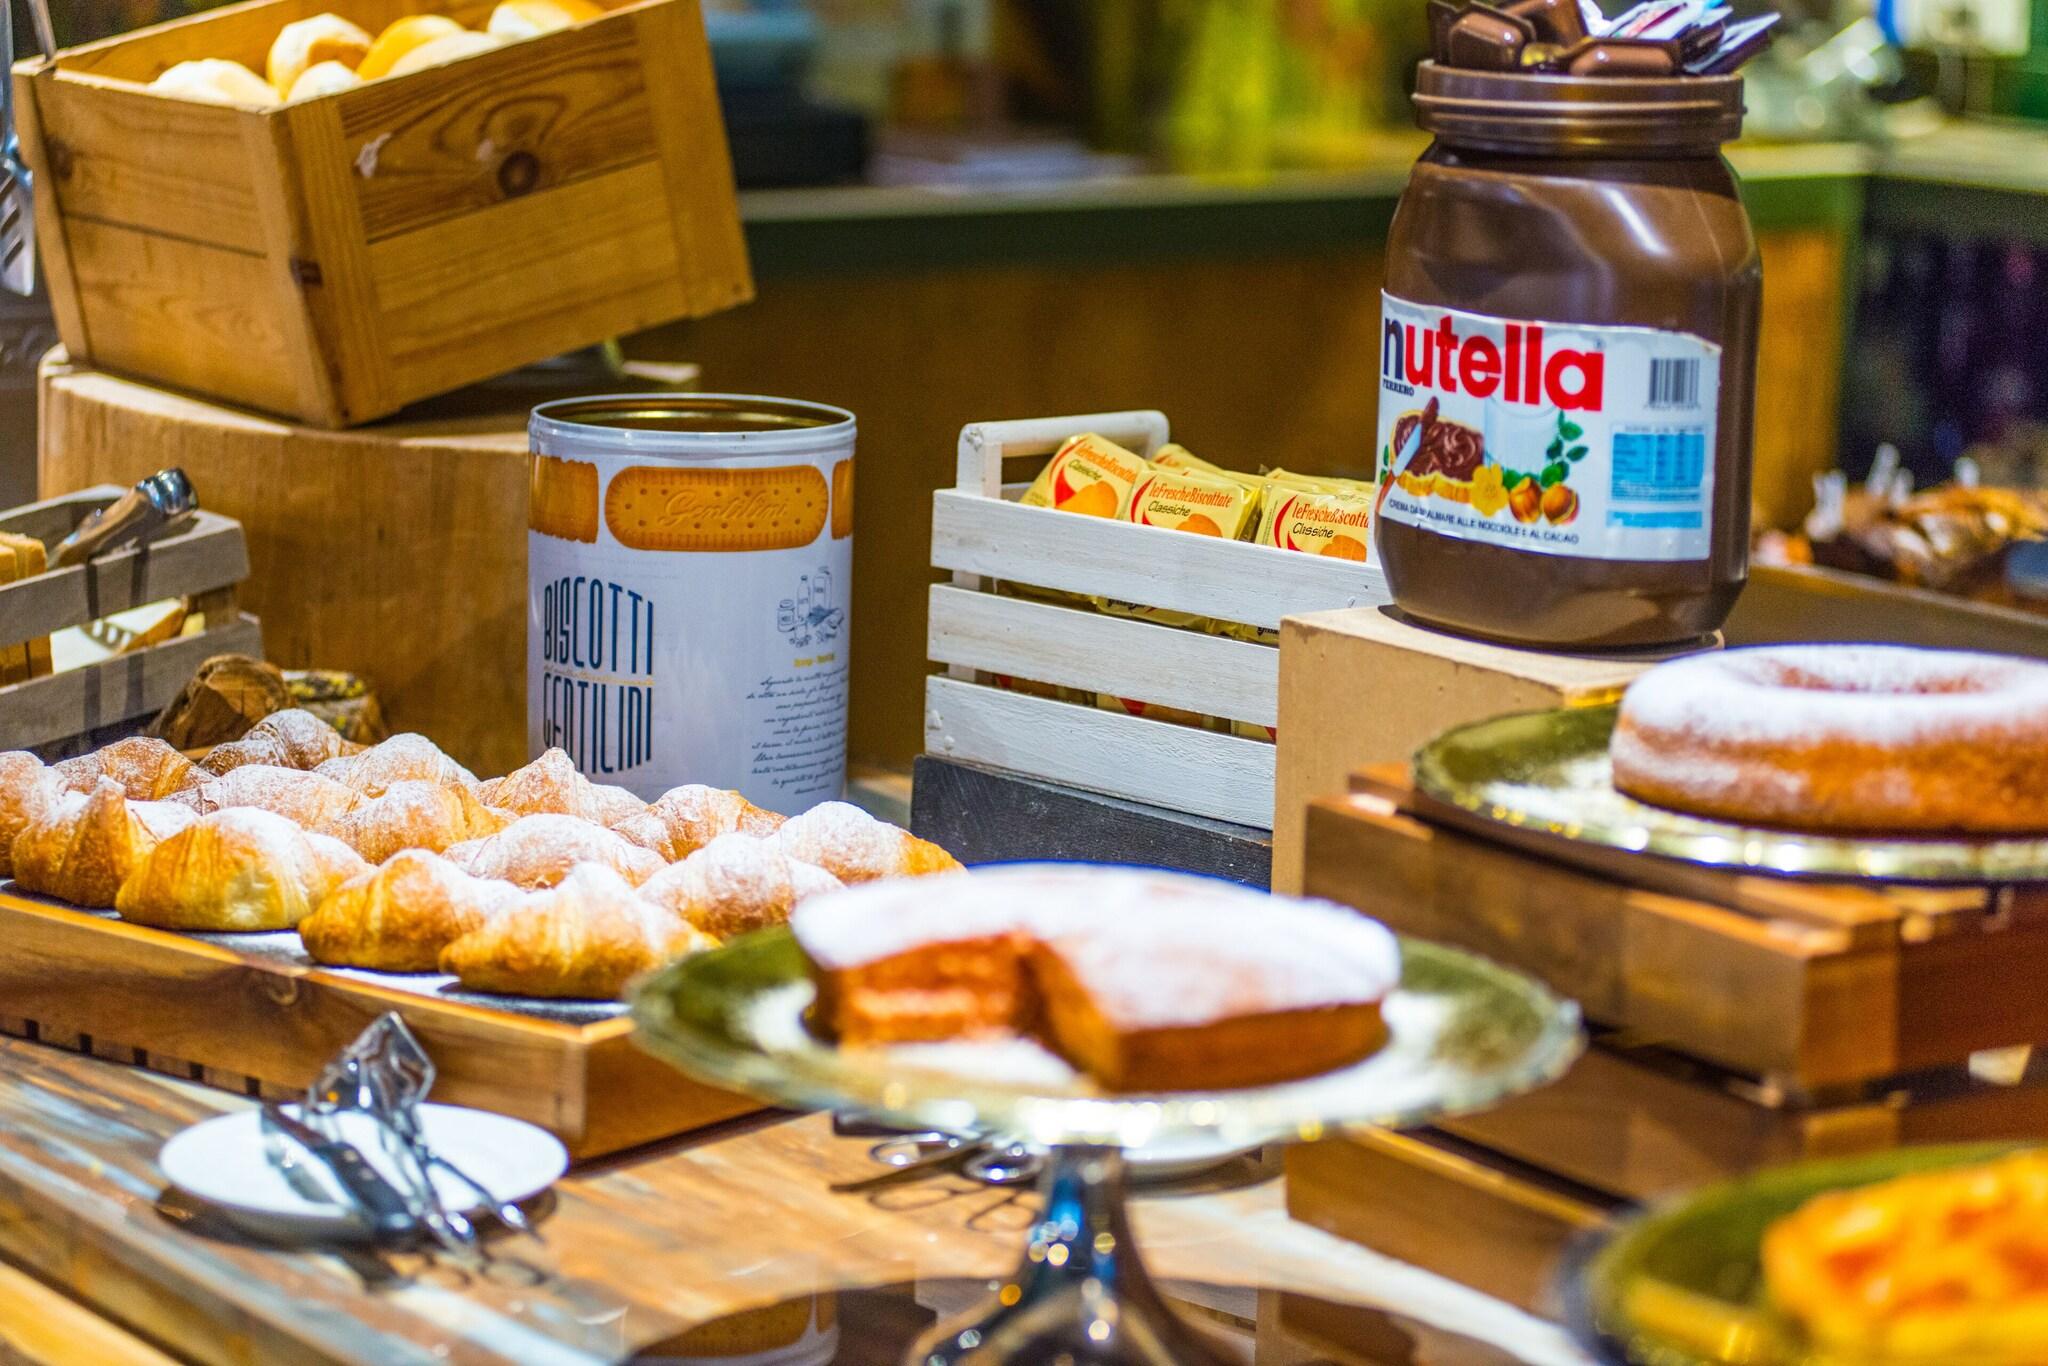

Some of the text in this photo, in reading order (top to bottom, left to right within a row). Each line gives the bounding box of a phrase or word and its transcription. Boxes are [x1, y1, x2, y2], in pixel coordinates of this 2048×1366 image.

[1383, 378, 1415, 397] FERRERO
[1384, 315, 1604, 411] nutella
[1148, 500, 1191, 517] Classiche
[1388, 498, 1409, 513] CREMA
[1457, 515, 1476, 529] ALLE
[1478, 519, 1519, 537] NOCCIOLE
[1530, 528, 1541, 539] AL
[1544, 531, 1579, 545] CACAO
[543, 576, 653, 675] BISCOTTI
[543, 672, 652, 774] GENTILINI
